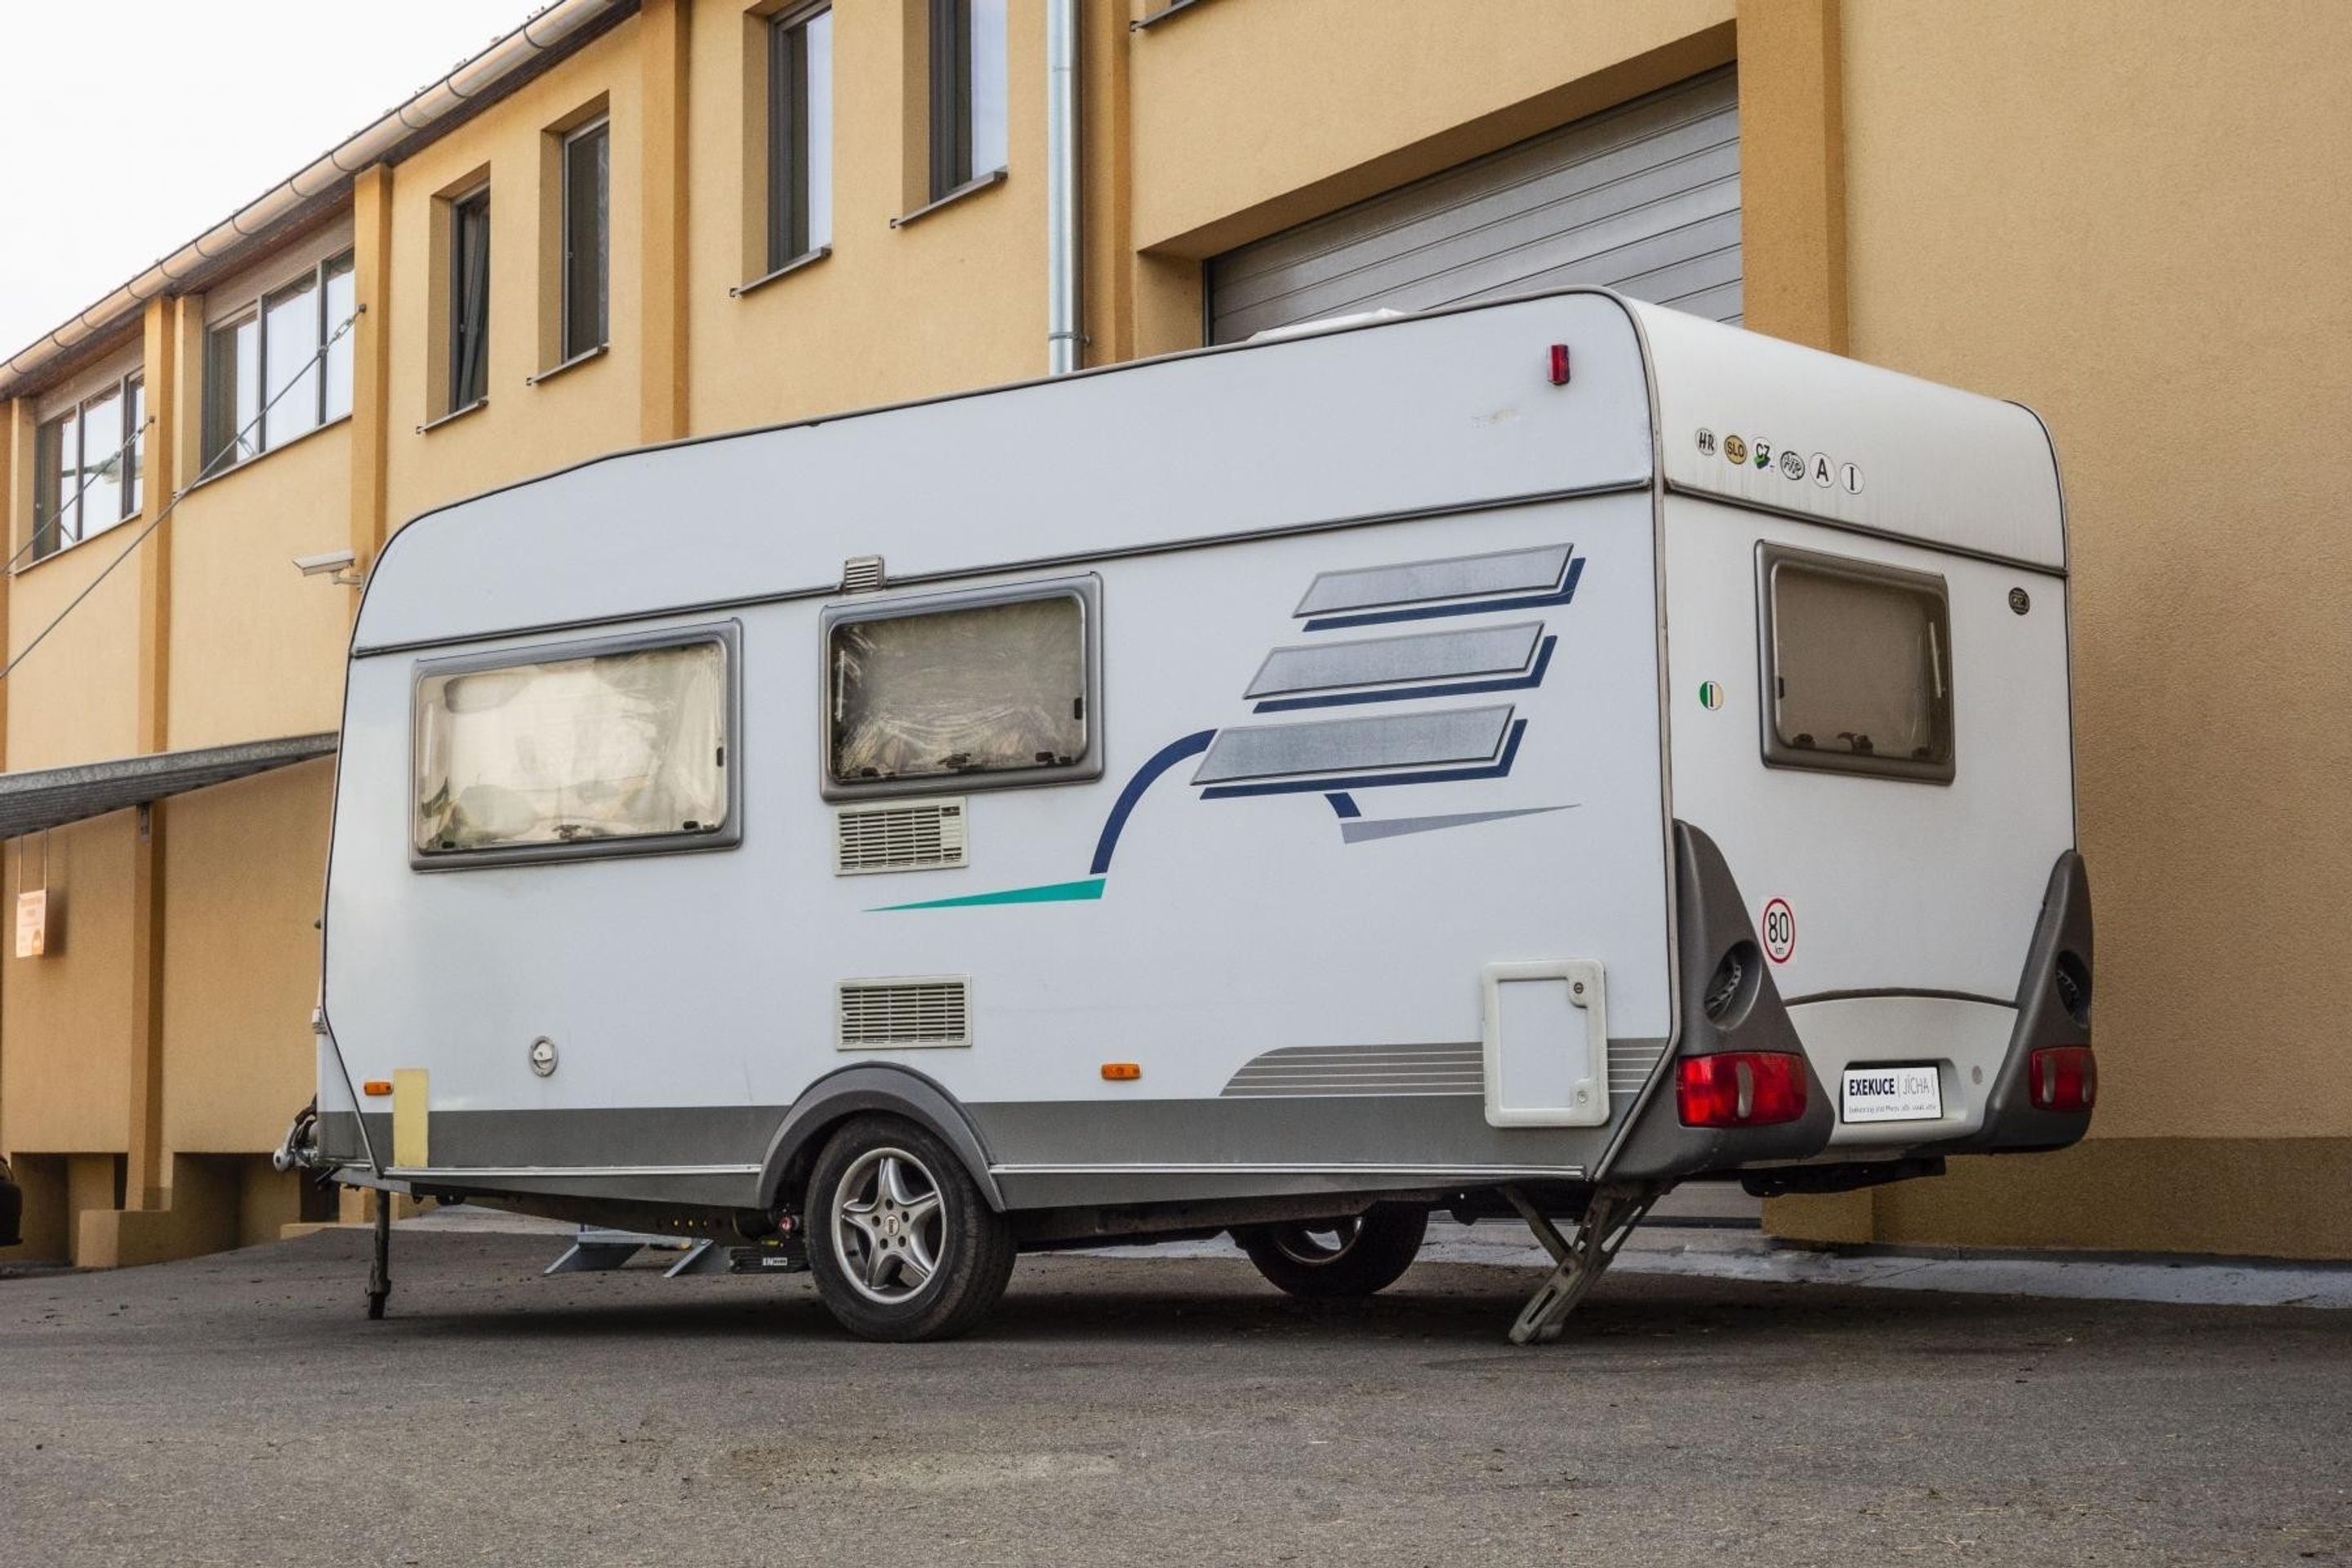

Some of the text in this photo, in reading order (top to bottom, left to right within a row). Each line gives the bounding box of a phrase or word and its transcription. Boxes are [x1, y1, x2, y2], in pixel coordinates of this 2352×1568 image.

[1699, 431, 1715, 451] HR
[1727, 442, 1745, 458] SLO
[1756, 443, 1771, 458] CZ
[1816, 457, 1829, 482] A
[1849, 466, 1855, 491] I
[1768, 911, 1788, 943] 80
[1849, 1078, 1895, 1096] EXEKUCE
